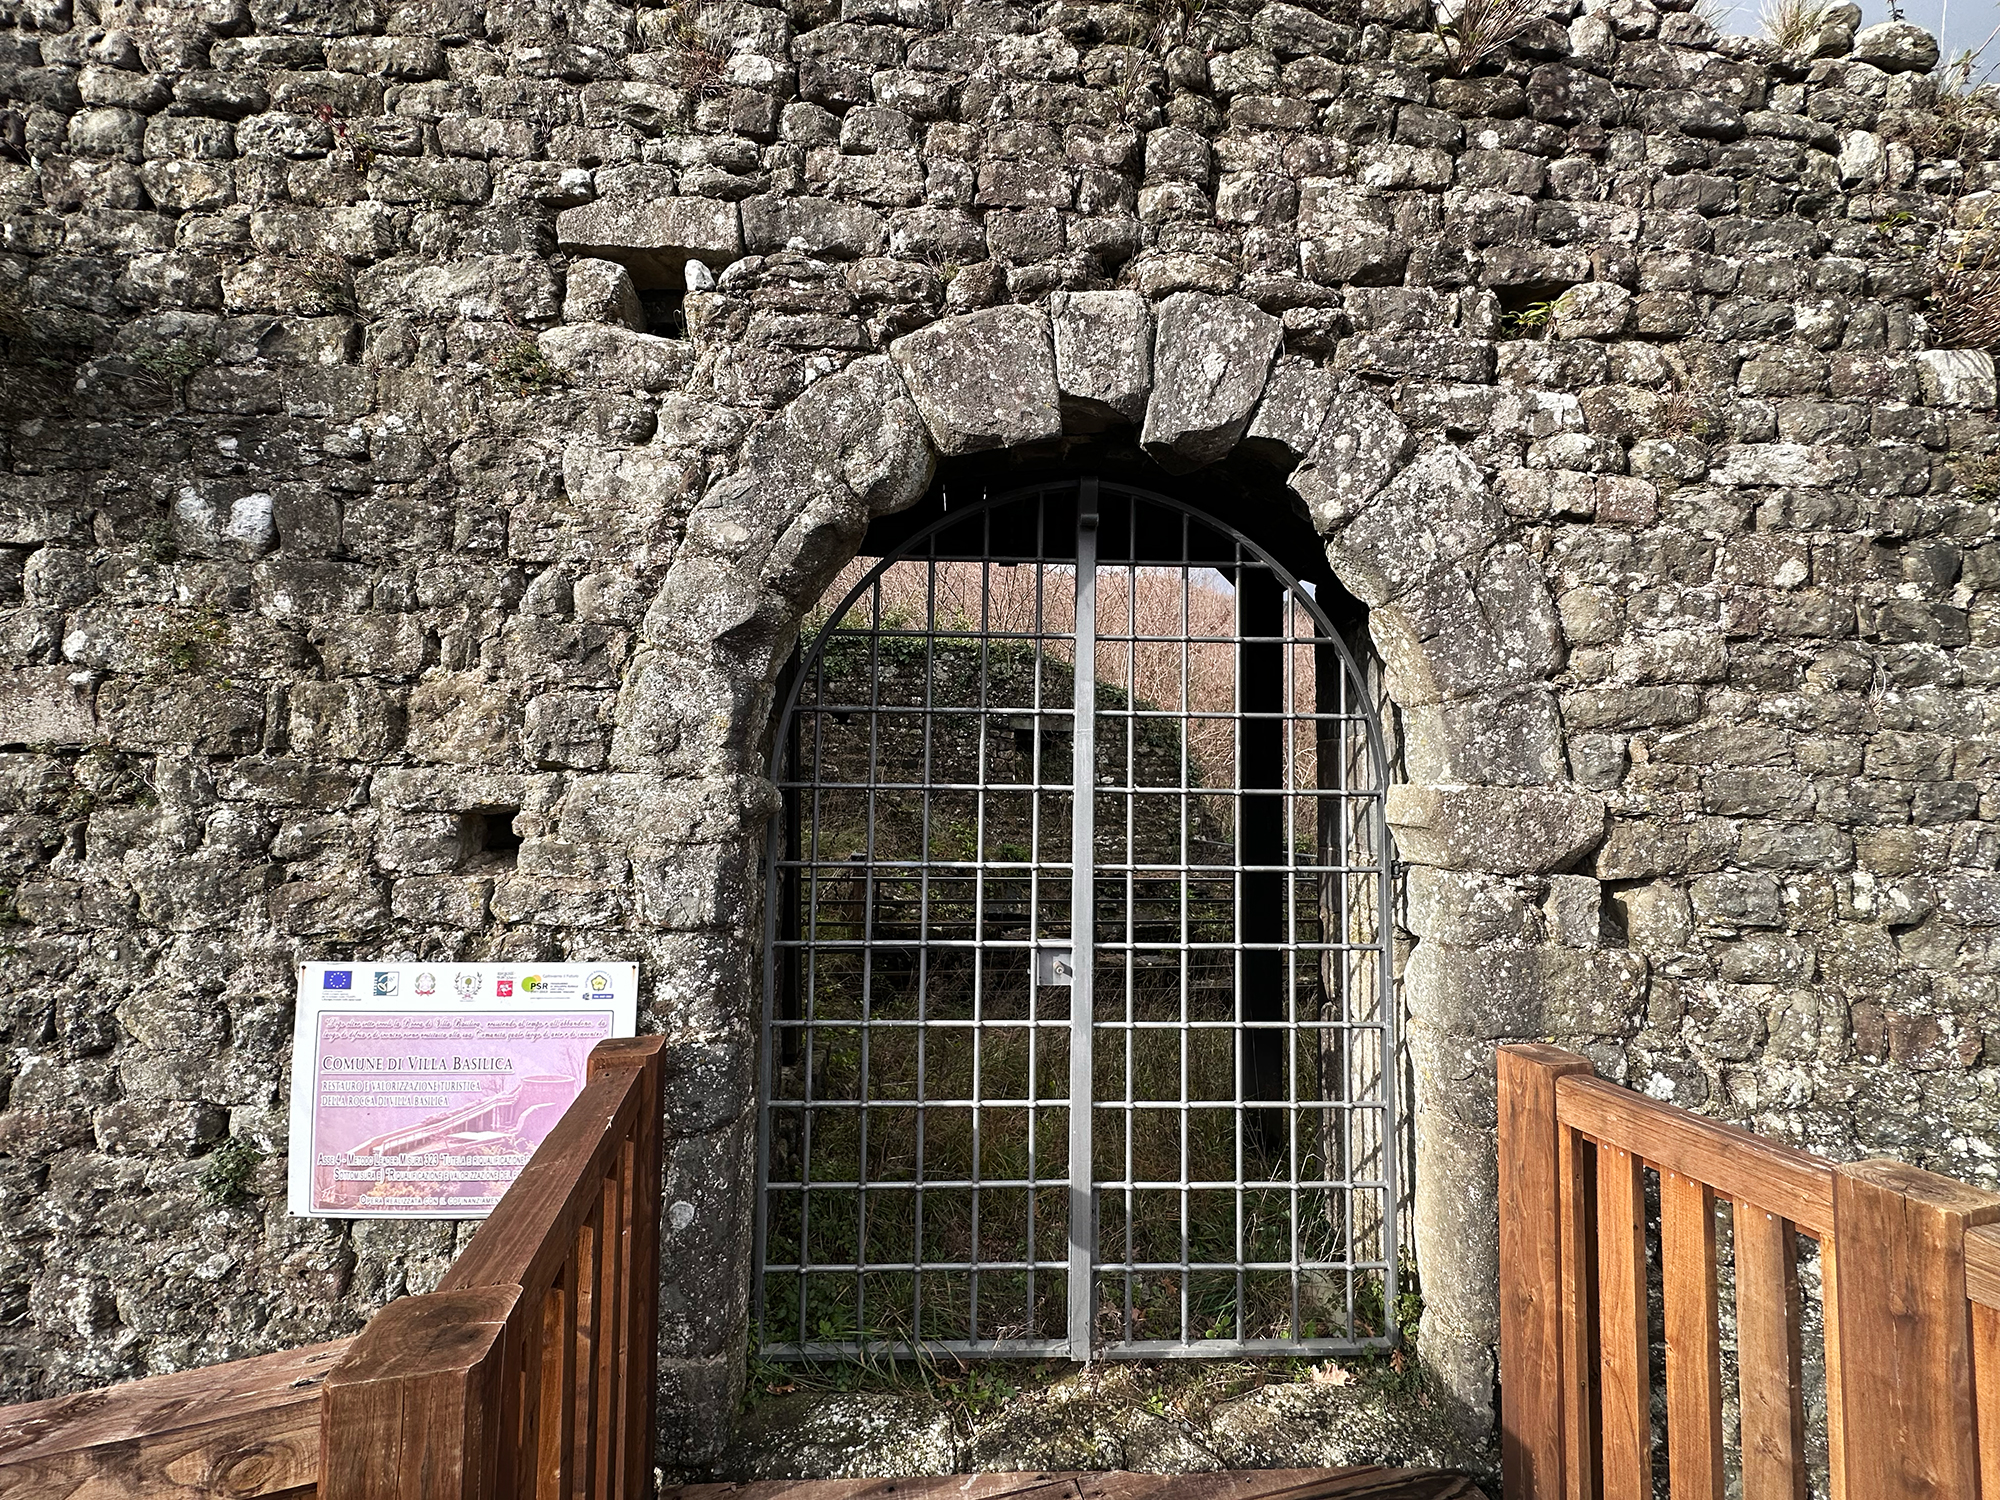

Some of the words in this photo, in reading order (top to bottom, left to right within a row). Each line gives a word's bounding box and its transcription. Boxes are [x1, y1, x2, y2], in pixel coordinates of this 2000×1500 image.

[530, 982, 549, 990] PSR
[322, 1057, 382, 1071] COMUNE
[388, 1058, 401, 1070] DI
[408, 1056, 447, 1070] VILLA
[452, 1056, 513, 1070] BASILICA
[322, 1081, 362, 1092] RESTAURO
[363, 1081, 369, 1091] E
[371, 1081, 438, 1091] VALORIZZAZIONE
[440, 1081, 481, 1091] TURISTICA
[321, 1096, 347, 1106] DELLA
[348, 1096, 376, 1106] ROCCA
[377, 1096, 388, 1106] DI
[389, 1096, 412, 1106] VILLA
[413, 1096, 449, 1106] BASILICA
[424, 1153, 438, 1166] 323
